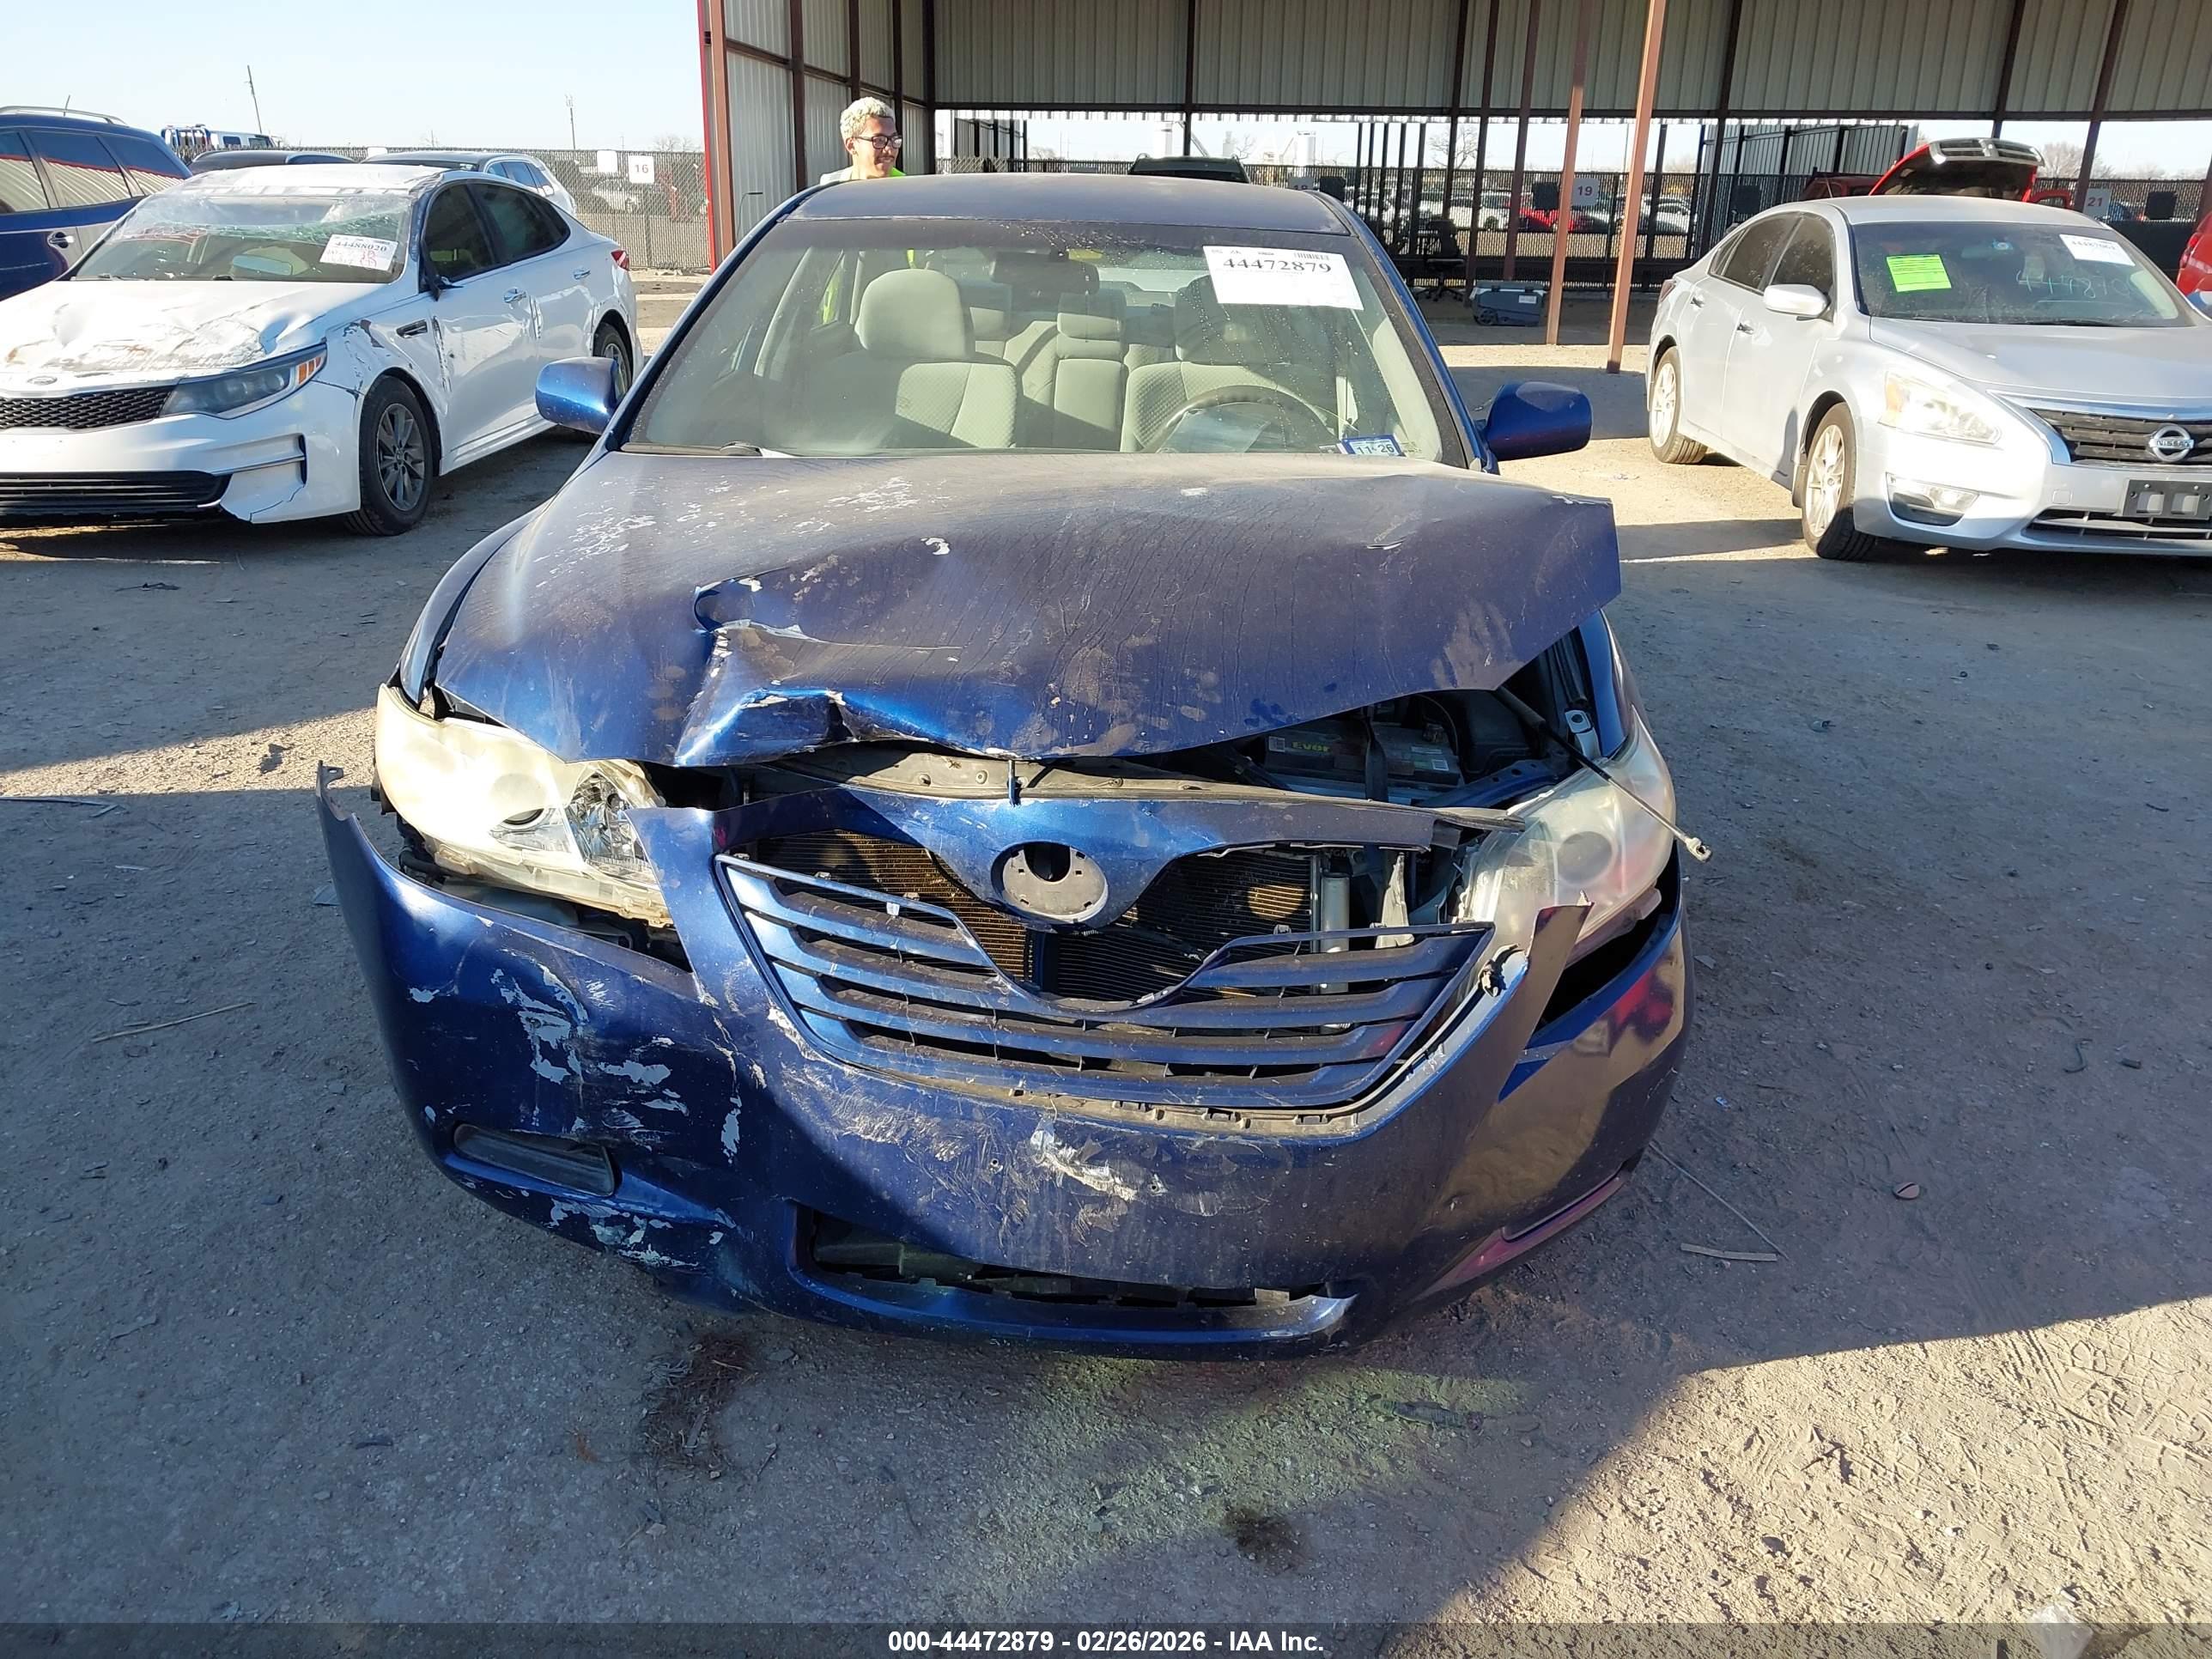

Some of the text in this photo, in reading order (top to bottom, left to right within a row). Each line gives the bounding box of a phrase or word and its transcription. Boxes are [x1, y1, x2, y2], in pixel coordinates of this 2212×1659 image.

[635, 164, 649, 173] 16
[1577, 185, 1593, 196] 19
[2087, 197, 2103, 206] 21
[1223, 258, 1332, 273] 44472879
[2156, 439, 2191, 447] NISSAN
[1377, 444, 1395, 453] 26
